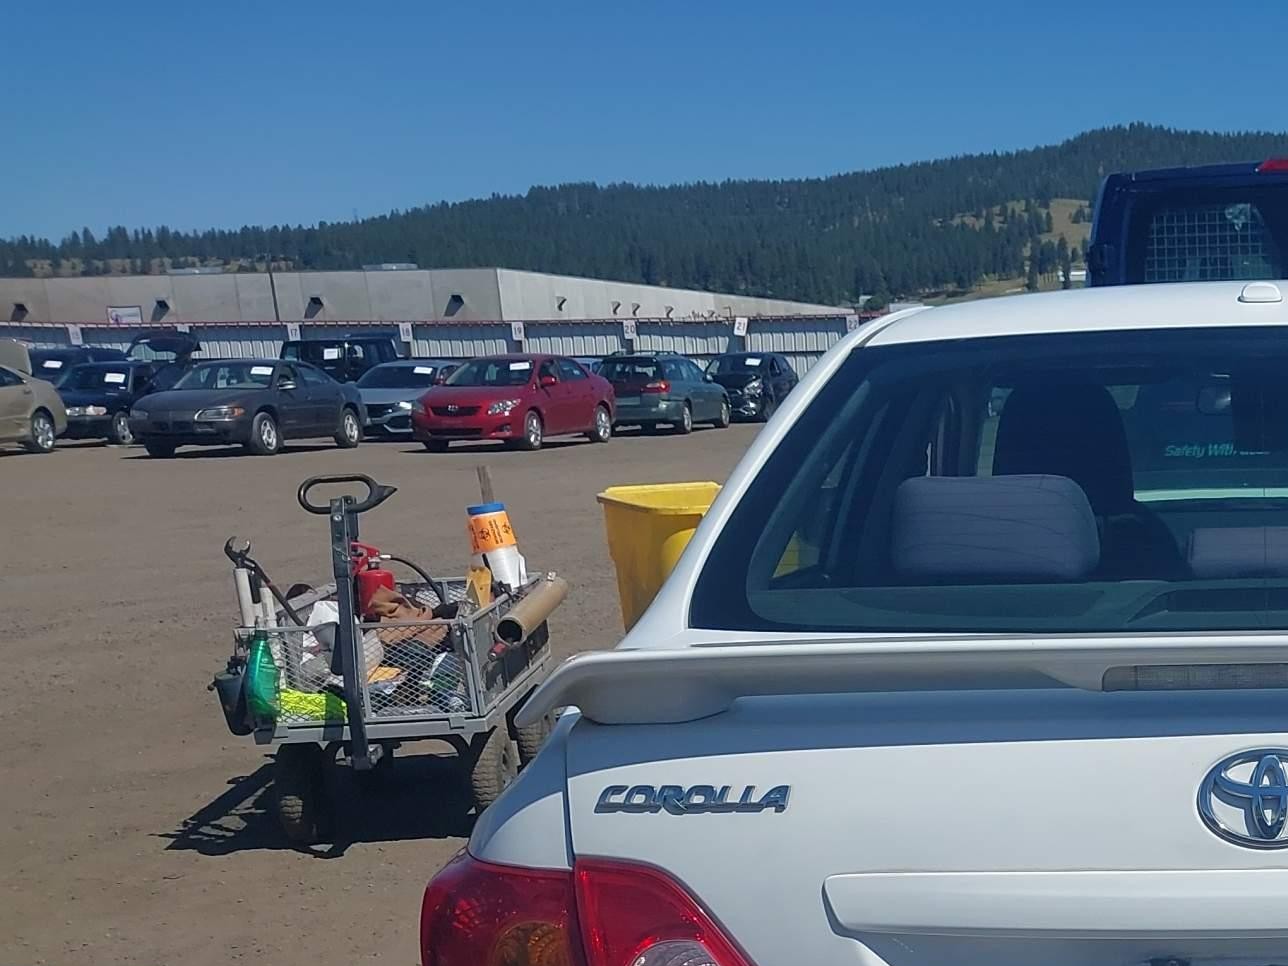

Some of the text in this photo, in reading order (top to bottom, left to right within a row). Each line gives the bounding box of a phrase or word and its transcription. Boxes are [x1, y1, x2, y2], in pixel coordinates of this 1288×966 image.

[624, 324, 636, 334] 20
[737, 321, 746, 331] 21
[290, 328, 298, 337] 17
[1164, 445, 1205, 458] Safety
[594, 785, 791, 815] COROLLA
